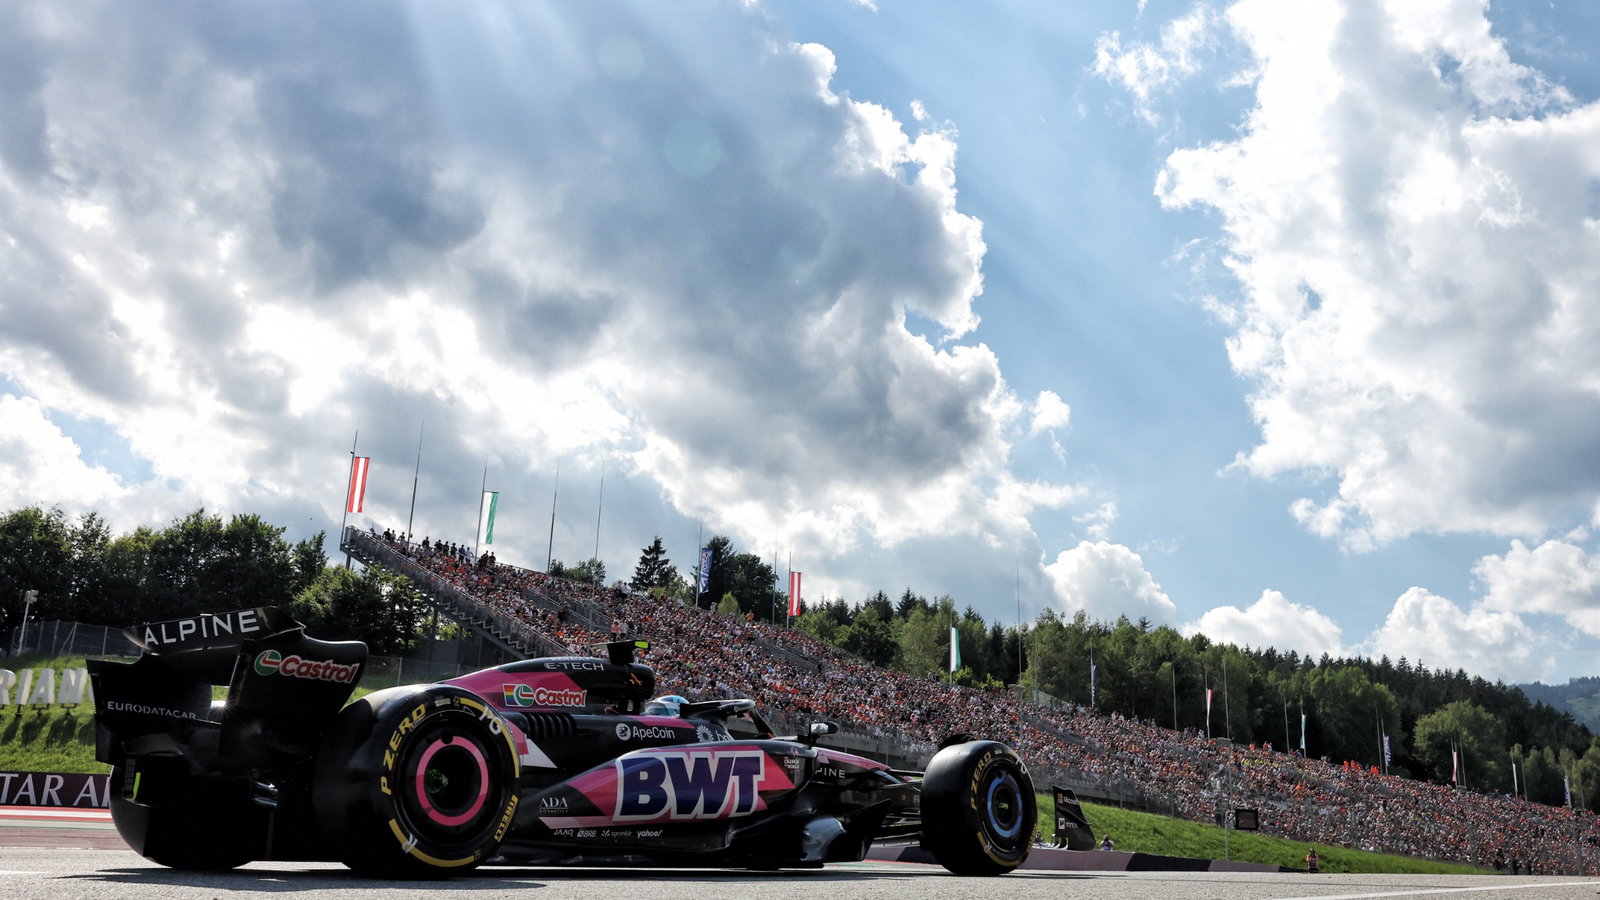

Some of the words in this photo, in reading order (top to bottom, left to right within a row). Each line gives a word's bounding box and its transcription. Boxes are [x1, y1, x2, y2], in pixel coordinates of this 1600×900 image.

[143, 610, 260, 646] ALPINE
[280, 655, 360, 684] Castrol
[544, 662, 604, 671] E-TECH
[534, 687, 588, 708] Castrol
[107, 701, 197, 720] EURODATACAR
[383, 703, 427, 772] ZERO
[632, 726, 675, 740] ApeCoin
[971, 751, 993, 795] ZERO
[0, 773, 62, 806] TAR
[381, 776, 392, 796] P
[613, 751, 764, 821] BWT
[540, 796, 568, 808] ADA
[553, 829, 574, 838] JAAQ
[637, 829, 663, 839] yahoo!
